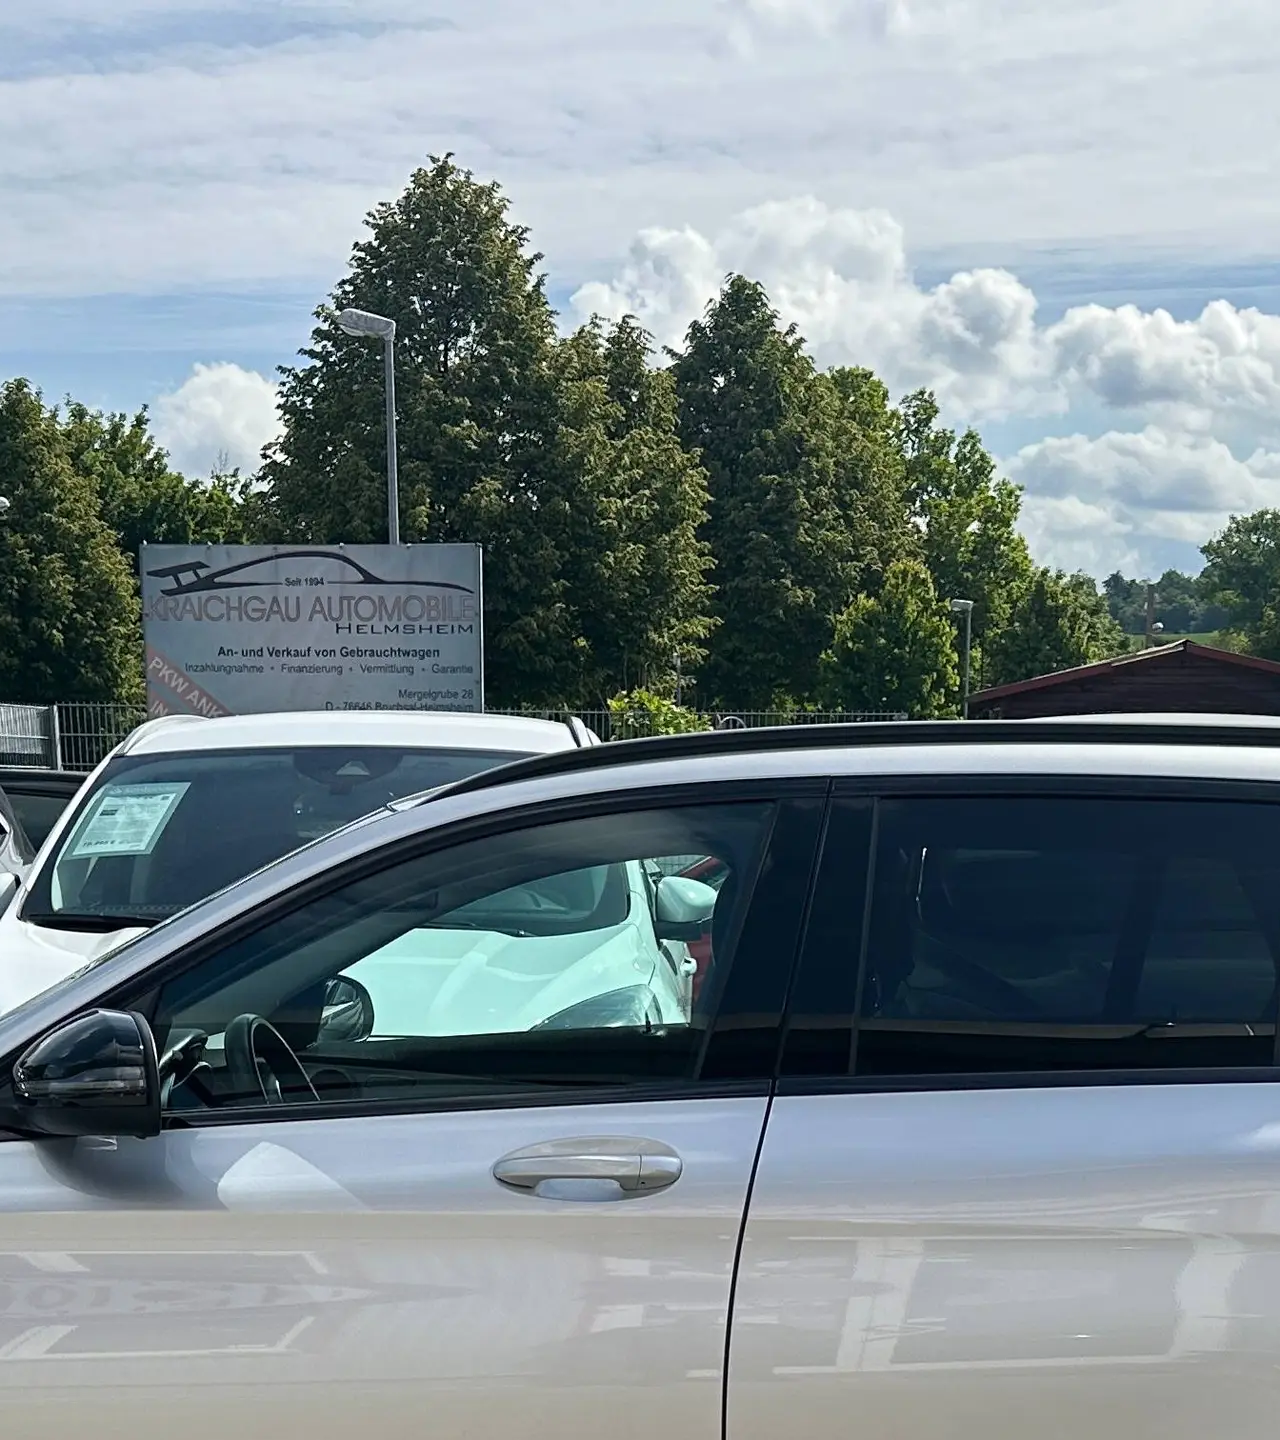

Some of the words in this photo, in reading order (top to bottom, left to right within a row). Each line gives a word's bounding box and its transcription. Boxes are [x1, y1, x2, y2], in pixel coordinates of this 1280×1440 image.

[284, 577, 302, 587] Seit
[147, 595, 301, 622] KRAICHGAU
[307, 594, 475, 623] AUTOMOBILE
[336, 623, 474, 635] HELMSHEIM
[217, 647, 238, 658] An-
[242, 647, 263, 658] und
[266, 647, 312, 658] Verkauf
[315, 649, 336, 658] von
[340, 647, 440, 661] Gebrauchtwagen
[149, 656, 189, 693] PKW
[185, 663, 264, 675] Inzahlungnahme
[281, 663, 343, 676] Finanzierung
[359, 663, 415, 676] Vermittlung
[431, 664, 473, 674] Garantie
[398, 689, 459, 701] Mergelgrube
[461, 689, 474, 699] 28
